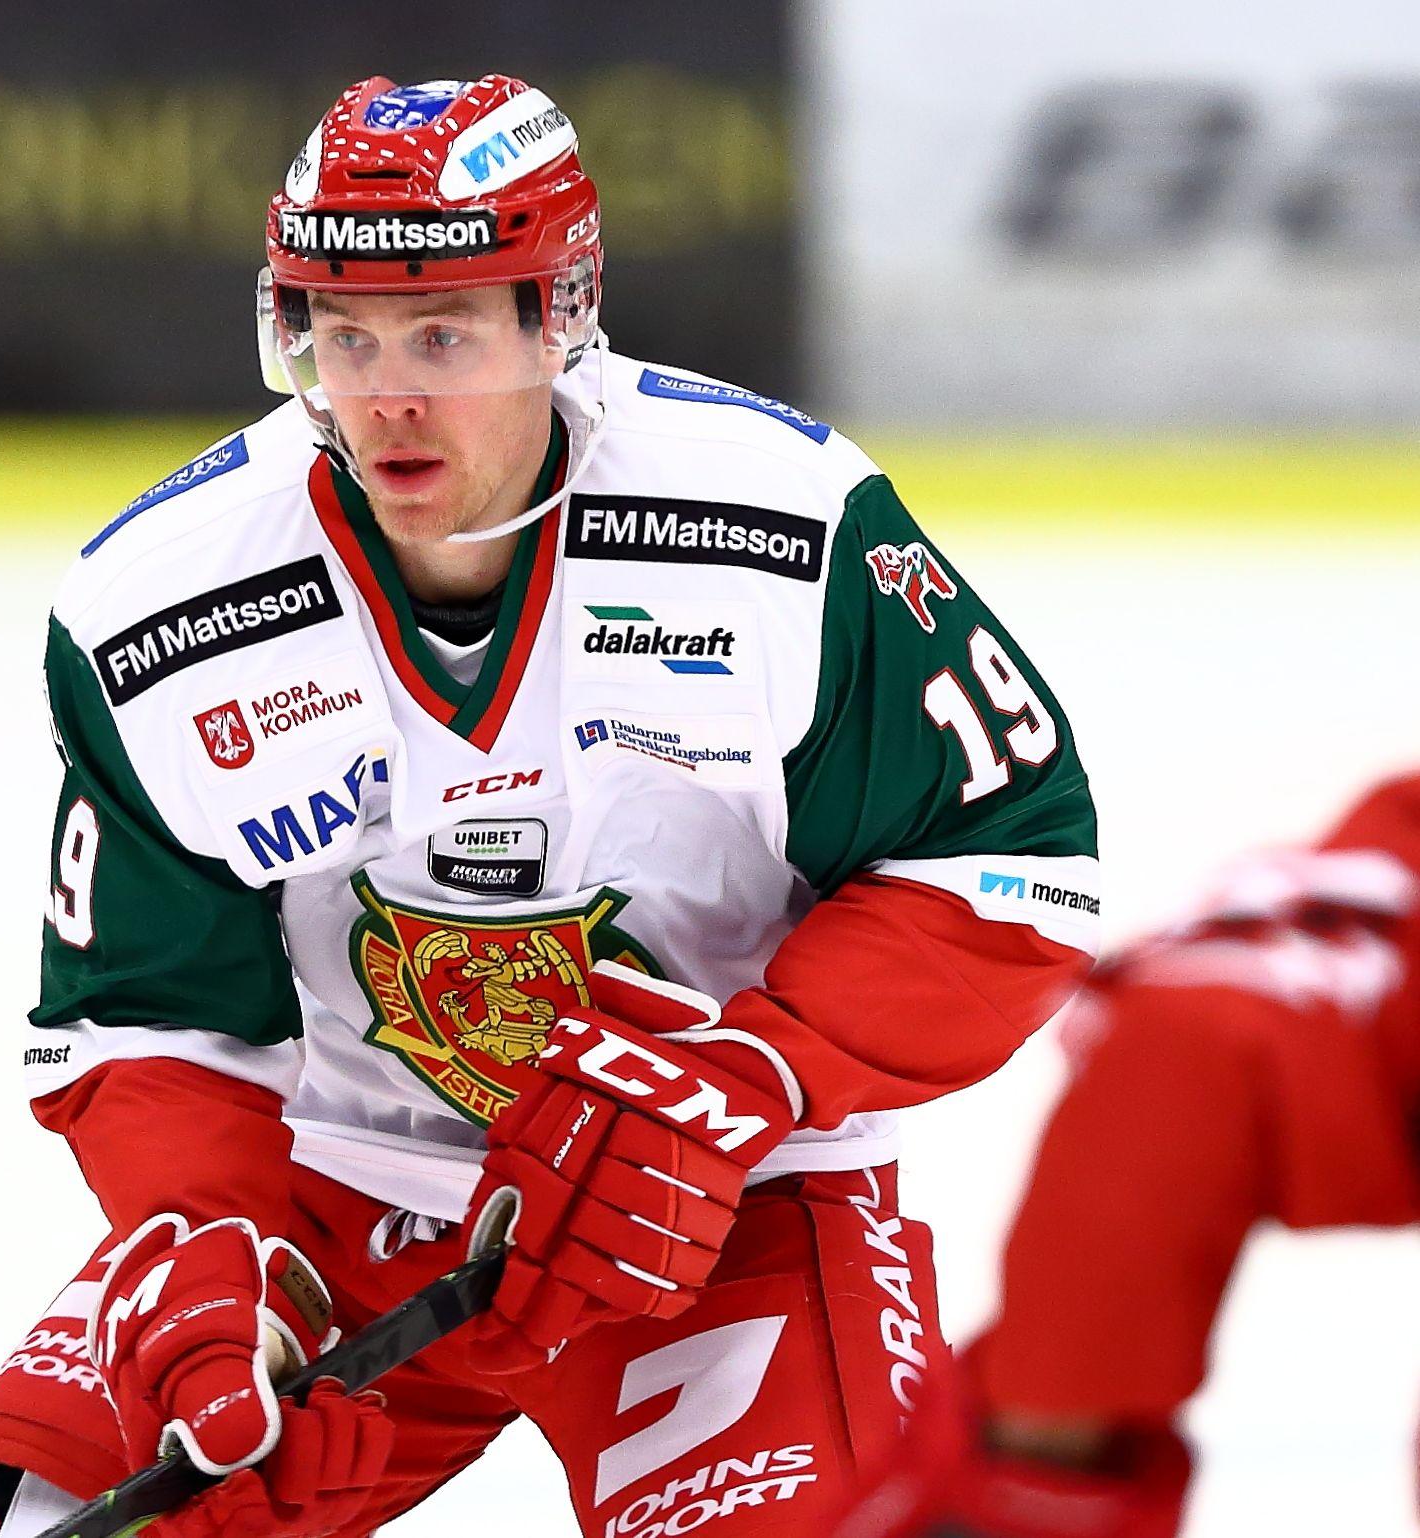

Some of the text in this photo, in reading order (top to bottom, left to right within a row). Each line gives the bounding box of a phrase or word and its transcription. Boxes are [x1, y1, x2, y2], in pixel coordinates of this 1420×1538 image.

[282, 214, 490, 250] FM Mattsson
[580, 508, 811, 566] FM Mattsson
[107, 580, 326, 688] FM Mattsson
[583, 624, 736, 657] dalakraft
[251, 680, 323, 719] MORA
[259, 688, 364, 739] KOMMUN
[923, 624, 1060, 807] 19
[610, 718, 682, 745] Dalarnas
[442, 768, 543, 803] CCM
[453, 830, 522, 846] UNIBET
[45, 795, 102, 953] 9
[366, 945, 414, 1025] MORA
[538, 1016, 770, 1154] CCM
